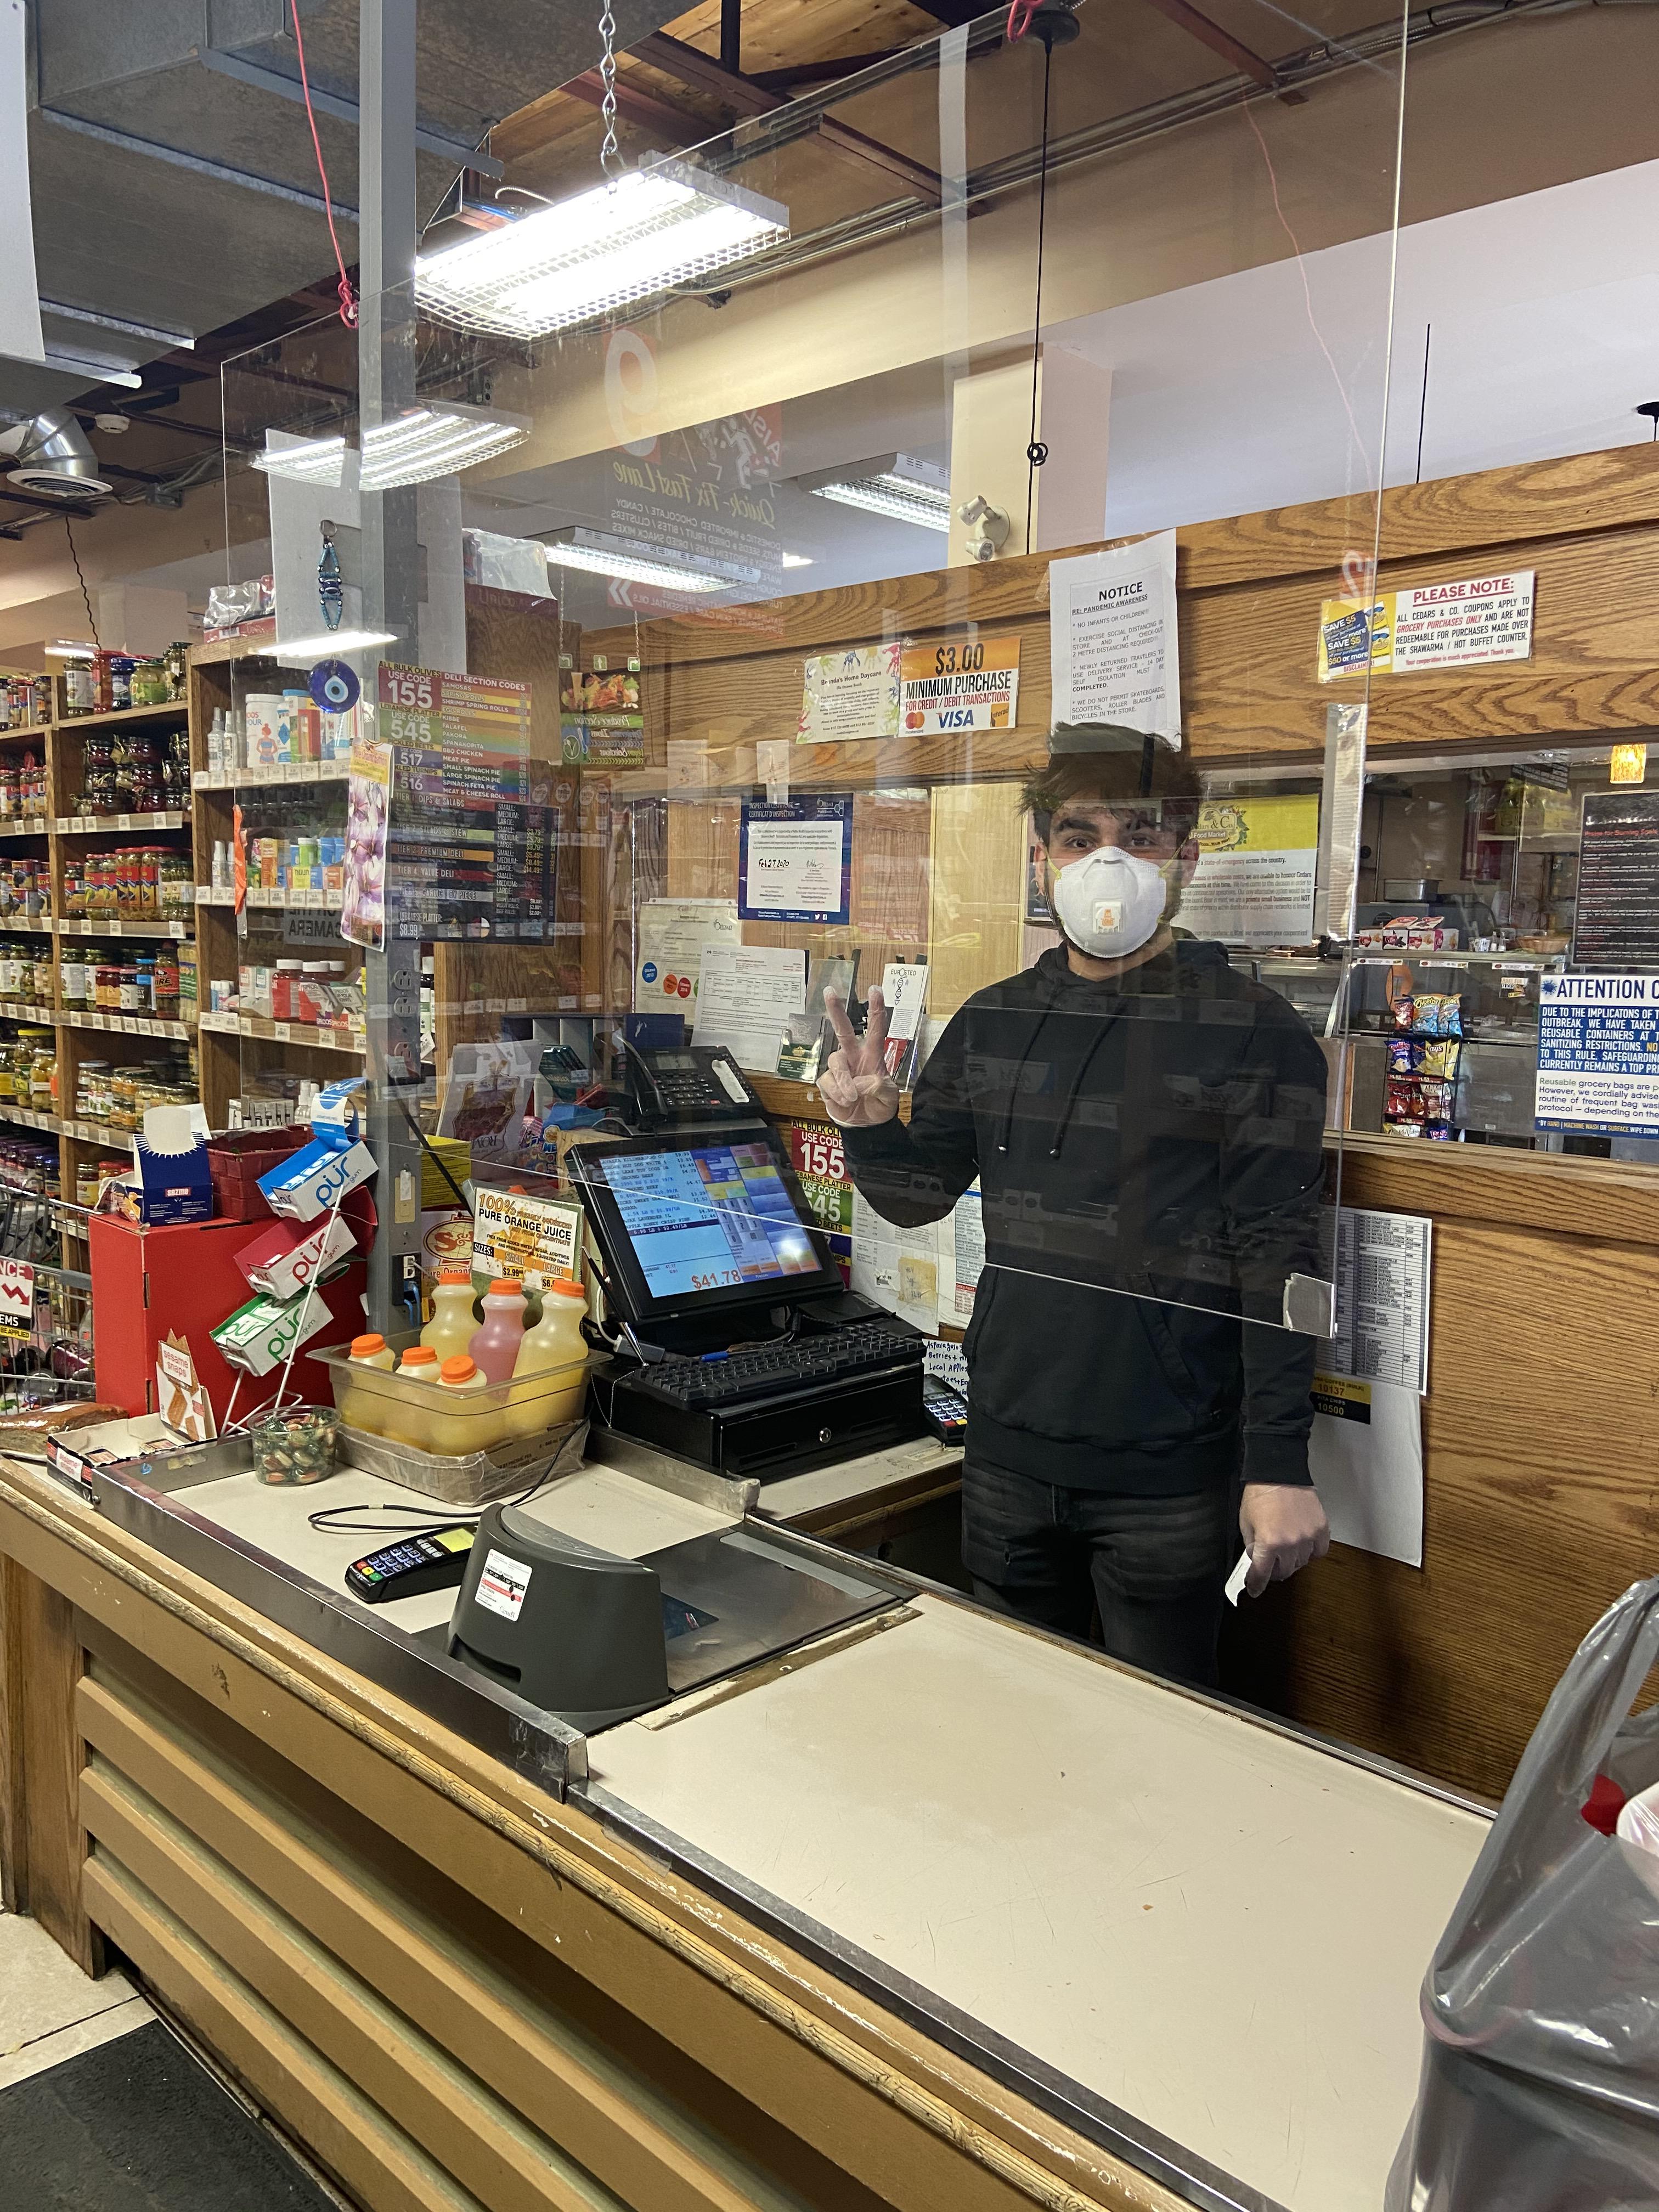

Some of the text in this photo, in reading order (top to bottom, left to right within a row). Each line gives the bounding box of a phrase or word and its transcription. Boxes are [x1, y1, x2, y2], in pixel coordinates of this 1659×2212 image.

[1099, 582, 1143, 601] NOTICE
[1414, 578, 1514, 602] PLEASE NOTE:
[1084, 602, 1114, 613] PANDEMIC
[1116, 594, 1148, 606] AWARENESS
[1413, 610, 1435, 620] CEDARS
[1464, 602, 1493, 613] COUPONS
[1498, 599, 1517, 608] APPLY
[1522, 596, 1530, 605] TO
[1397, 622, 1425, 633] GROCERY
[1427, 617, 1463, 629] PURCHASES
[1466, 614, 1482, 624] ONLY
[1501, 611, 1513, 619] ARE
[1517, 608, 1529, 617] NOT
[1396, 620, 1528, 644] REDEEMABLE FOR PURCHASES MADE OVER
[1328, 636, 1361, 650] SAVE $5
[1396, 632, 1527, 656] THE SHAWARMA HOT BUFFET COUNTER.
[935, 643, 984, 676] $3.00
[1328, 657, 1341, 665] $50
[379, 661, 441, 676] ALL BULK OLIVES
[388, 671, 431, 685] USE CODE
[464, 676, 497, 686] SECTION
[499, 681, 526, 691] CODES
[844, 671, 882, 683] Home Daycare
[906, 671, 1011, 699] MINIMUM PURCHASE
[388, 680, 432, 709] 155
[906, 691, 1009, 711] FOR CREDIT DEBIT TRANSACTIONS
[381, 703, 439, 718] LEBANESE PLATTER
[392, 712, 430, 723] USE CODE
[938, 710, 974, 727] VISA
[391, 720, 431, 742] 545
[400, 753, 423, 766] 517
[400, 778, 423, 791] 516
[759, 858, 767, 867] Feb
[777, 859, 789, 867] 2020
[714, 919, 732, 930] Ottawa
[1557, 979, 1645, 998] ATTENTION
[1415, 998, 1440, 1009] Cheetos
[1543, 1007, 1557, 1017] DUE
[1560, 1007, 1568, 1017] TO
[1571, 1008, 1585, 1017] THE
[1642, 1009, 1652, 1019] OF
[1589, 1019, 1600, 1028] WE
[1606, 1020, 1626, 1029] HAVE
[1631, 1020, 1656, 1030] TAKEN
[1542, 1028, 1650, 1041] REUSABLE CONTAINERS AT
[1541, 1039, 1657, 1052] SANITIZING RESTRICTIONS. NO
[1541, 1049, 1549, 1058] TO
[1554, 1049, 1571, 1059] THIS
[1576, 1051, 1597, 1060] RULE.
[1540, 1060, 1644, 1073] CURRENTLY REMAINS A TOP
[1579, 1081, 1611, 1090] grocery
[1613, 1082, 1634, 1090] bags
[1539, 1087, 1575, 1096] However,
[1593, 1091, 1628, 1099] cordially
[792, 1121, 826, 1135] ALL BULK
[802, 1132, 844, 1149] USE CODE
[800, 1143, 844, 1179] 155
[349, 1169, 362, 1183] gum
[803, 1182, 840, 1198] USE CODE
[824, 1180, 851, 1190] PLATTER
[479, 1193, 516, 1215] 100%
[478, 1208, 571, 1240] PURE ORANGE JUICE
[474, 1243, 494, 1256] SIZES:
[505, 1252, 524, 1265] SMALL
[543, 1263, 563, 1276] LARGE
[692, 1270, 741, 1290] $41.78
[8, 1328, 29, 1339] APPLIED
[164, 1350, 188, 1377] sesame snaps
[930, 1363, 945, 1371] Local
[1318, 1384, 1344, 1396] 10137
[1318, 1403, 1344, 1415] 10500
